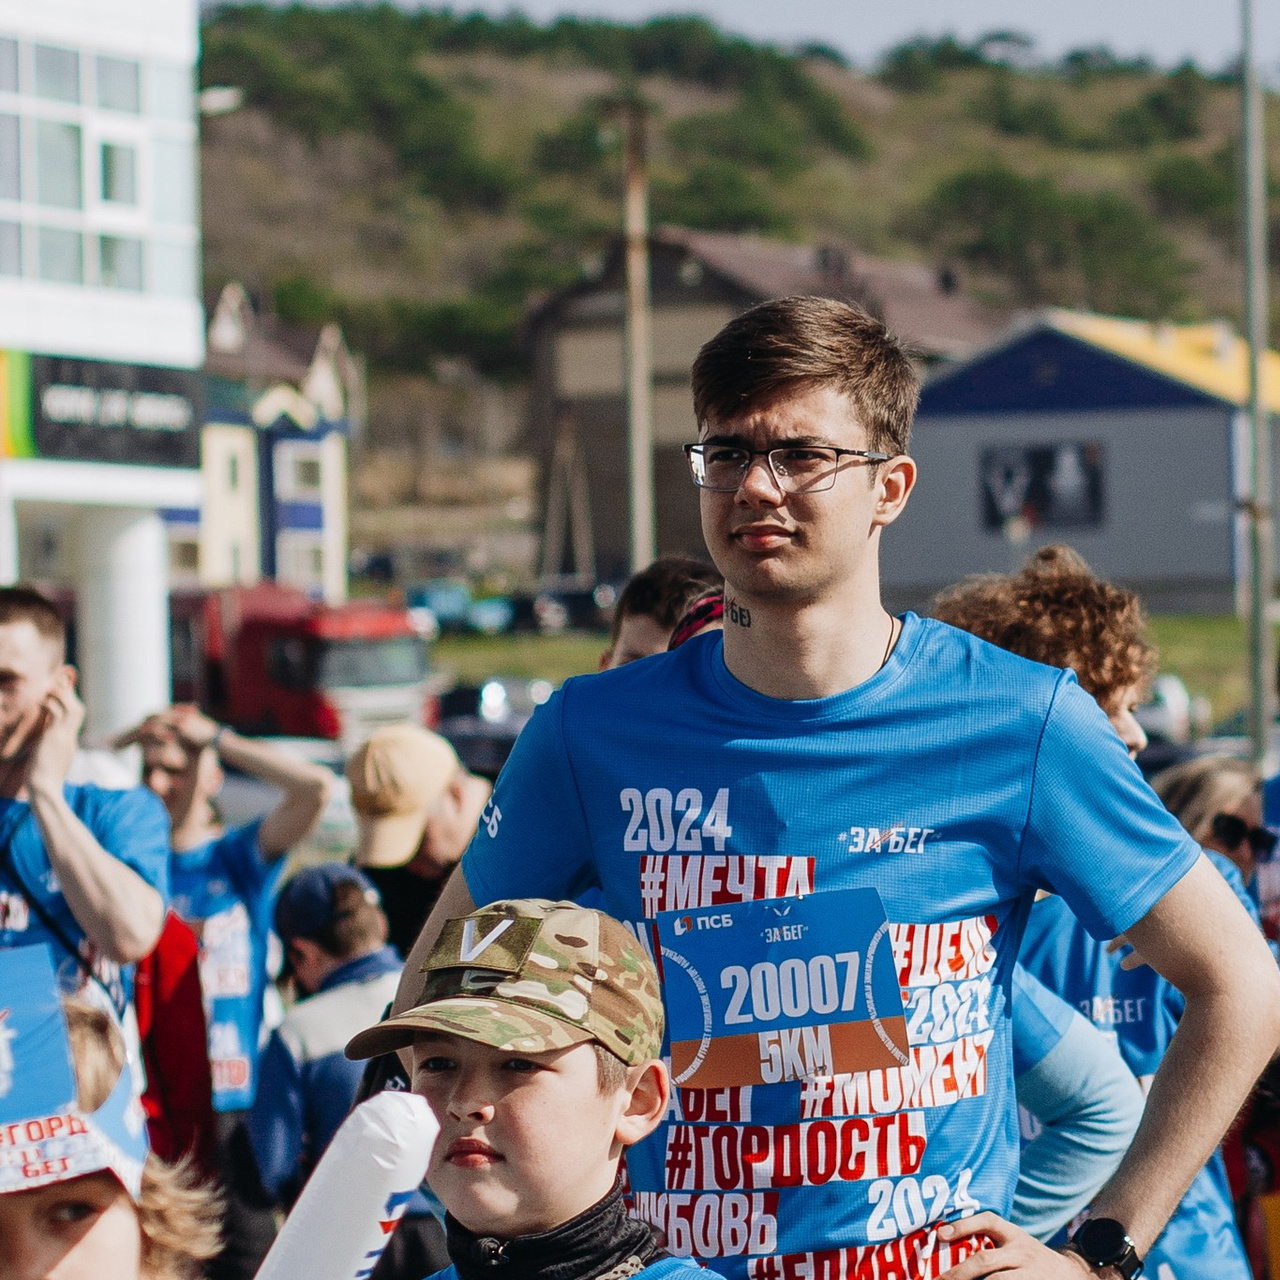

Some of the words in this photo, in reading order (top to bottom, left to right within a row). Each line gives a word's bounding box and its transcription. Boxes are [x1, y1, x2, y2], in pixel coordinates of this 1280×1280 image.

[620, 788, 732, 852] 2024
[697, 914, 733, 930] ПСБ
[720, 951, 860, 1025] 20007
[665, 1112, 927, 1191] #ГОРДОСТЬ
